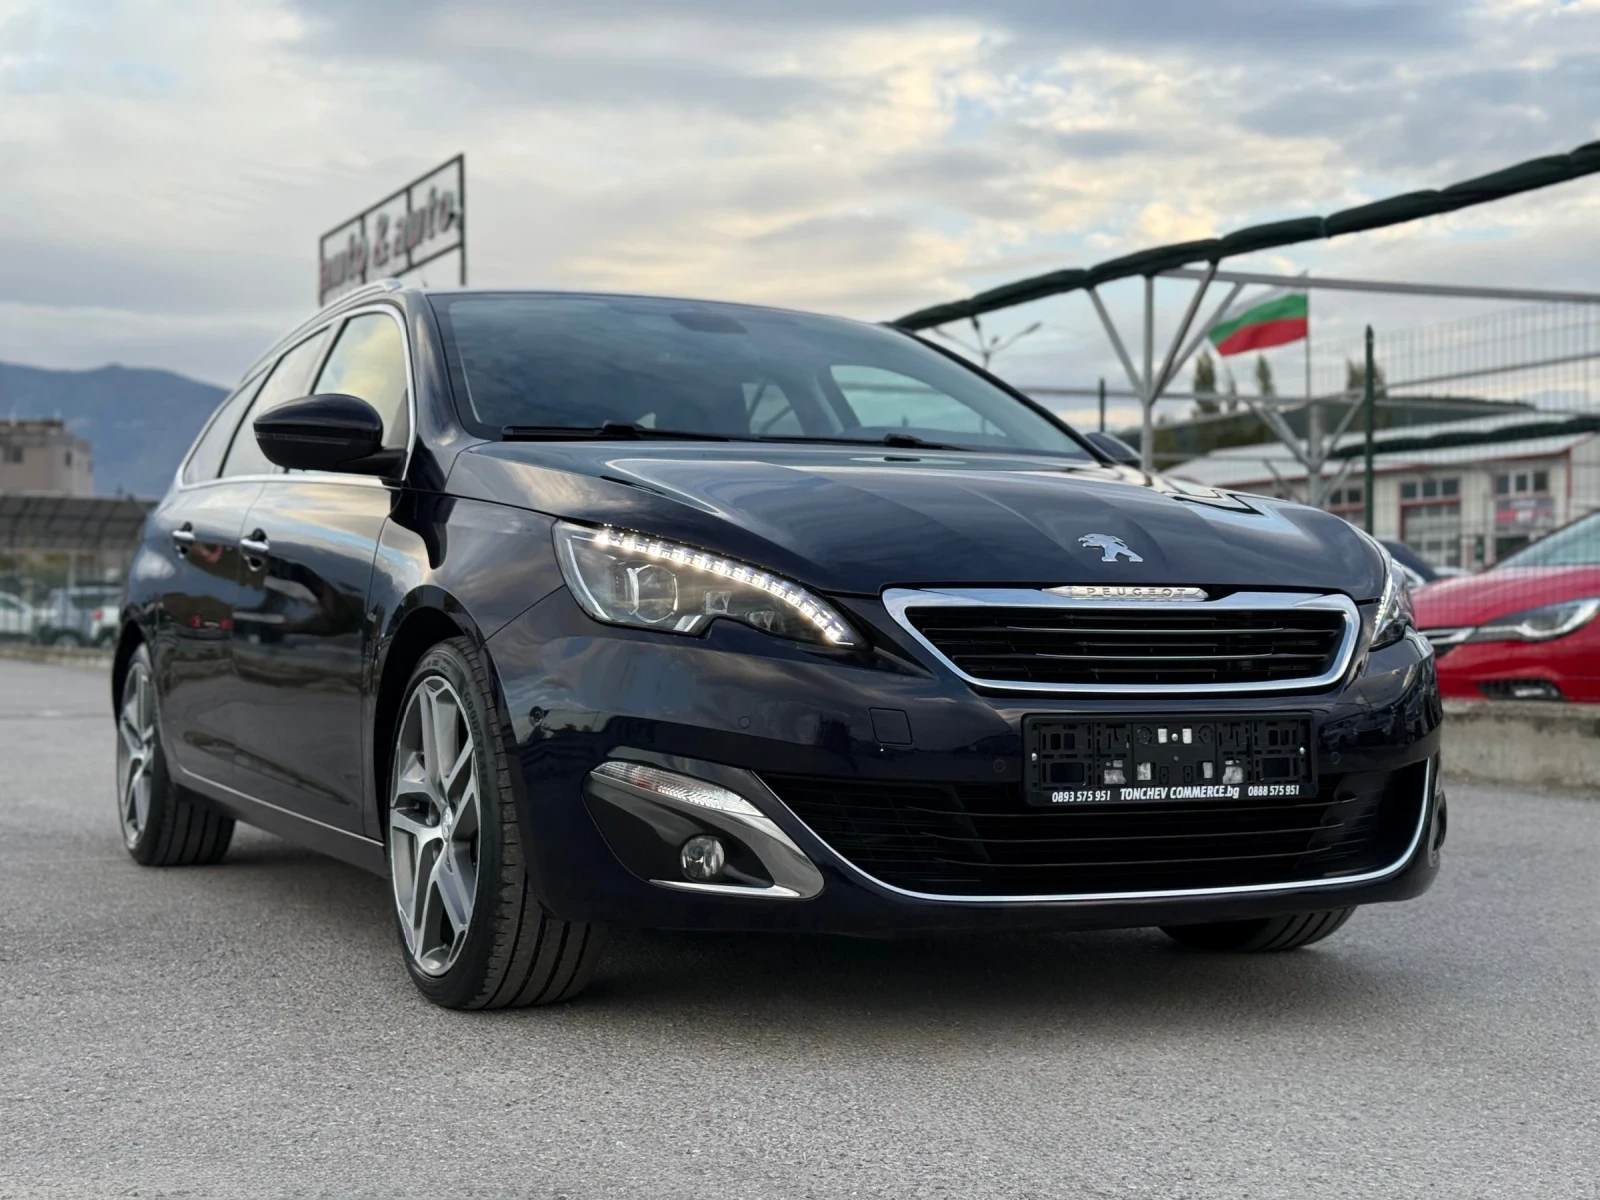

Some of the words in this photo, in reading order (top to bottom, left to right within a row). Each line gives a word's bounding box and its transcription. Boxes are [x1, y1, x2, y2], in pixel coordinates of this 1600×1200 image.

[1086, 587, 1186, 597] PEUGEOT
[1051, 791, 1075, 803] 0893
[1076, 791, 1093, 802] 575
[1094, 790, 1111, 801] 951
[1119, 787, 1168, 801] TONCHEV
[1169, 785, 1240, 799] COMMERCE.bg
[1247, 785, 1268, 797] 0888
[1269, 785, 1285, 796] 575
[1285, 784, 1300, 795] 951
